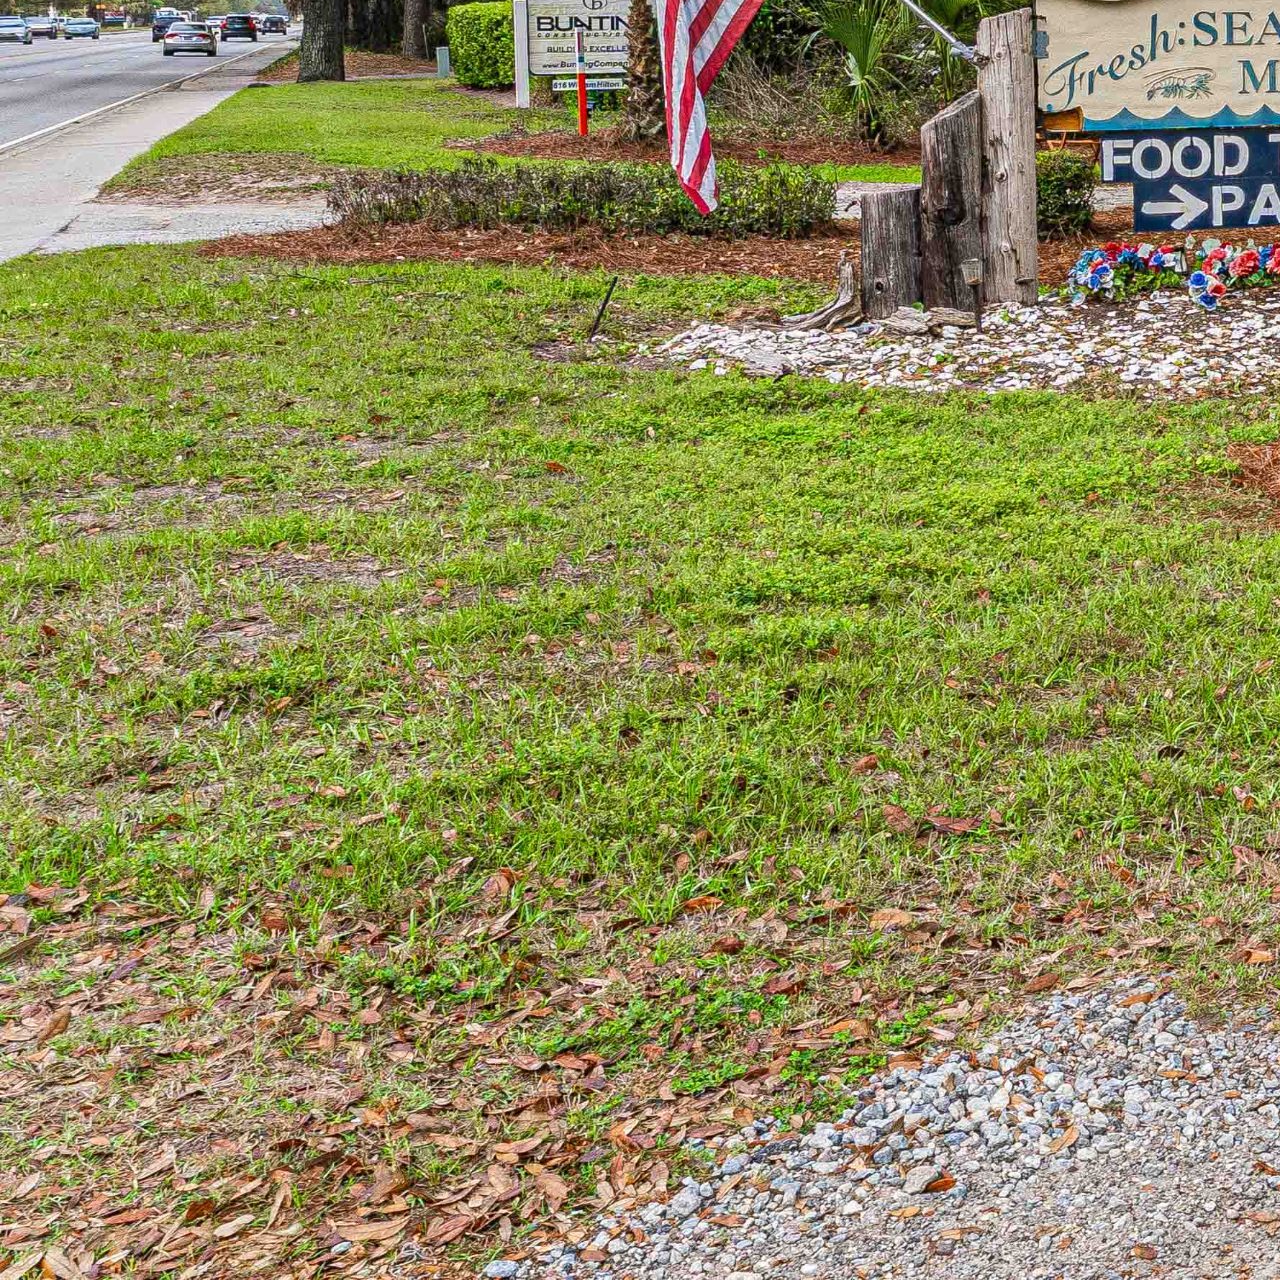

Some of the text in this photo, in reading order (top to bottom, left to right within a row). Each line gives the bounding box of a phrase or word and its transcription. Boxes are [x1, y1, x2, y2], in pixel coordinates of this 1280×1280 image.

[536, 16, 629, 31] BUNTIN
[597, 80, 620, 88] Hilton
[1101, 134, 1249, 181] FOOD
